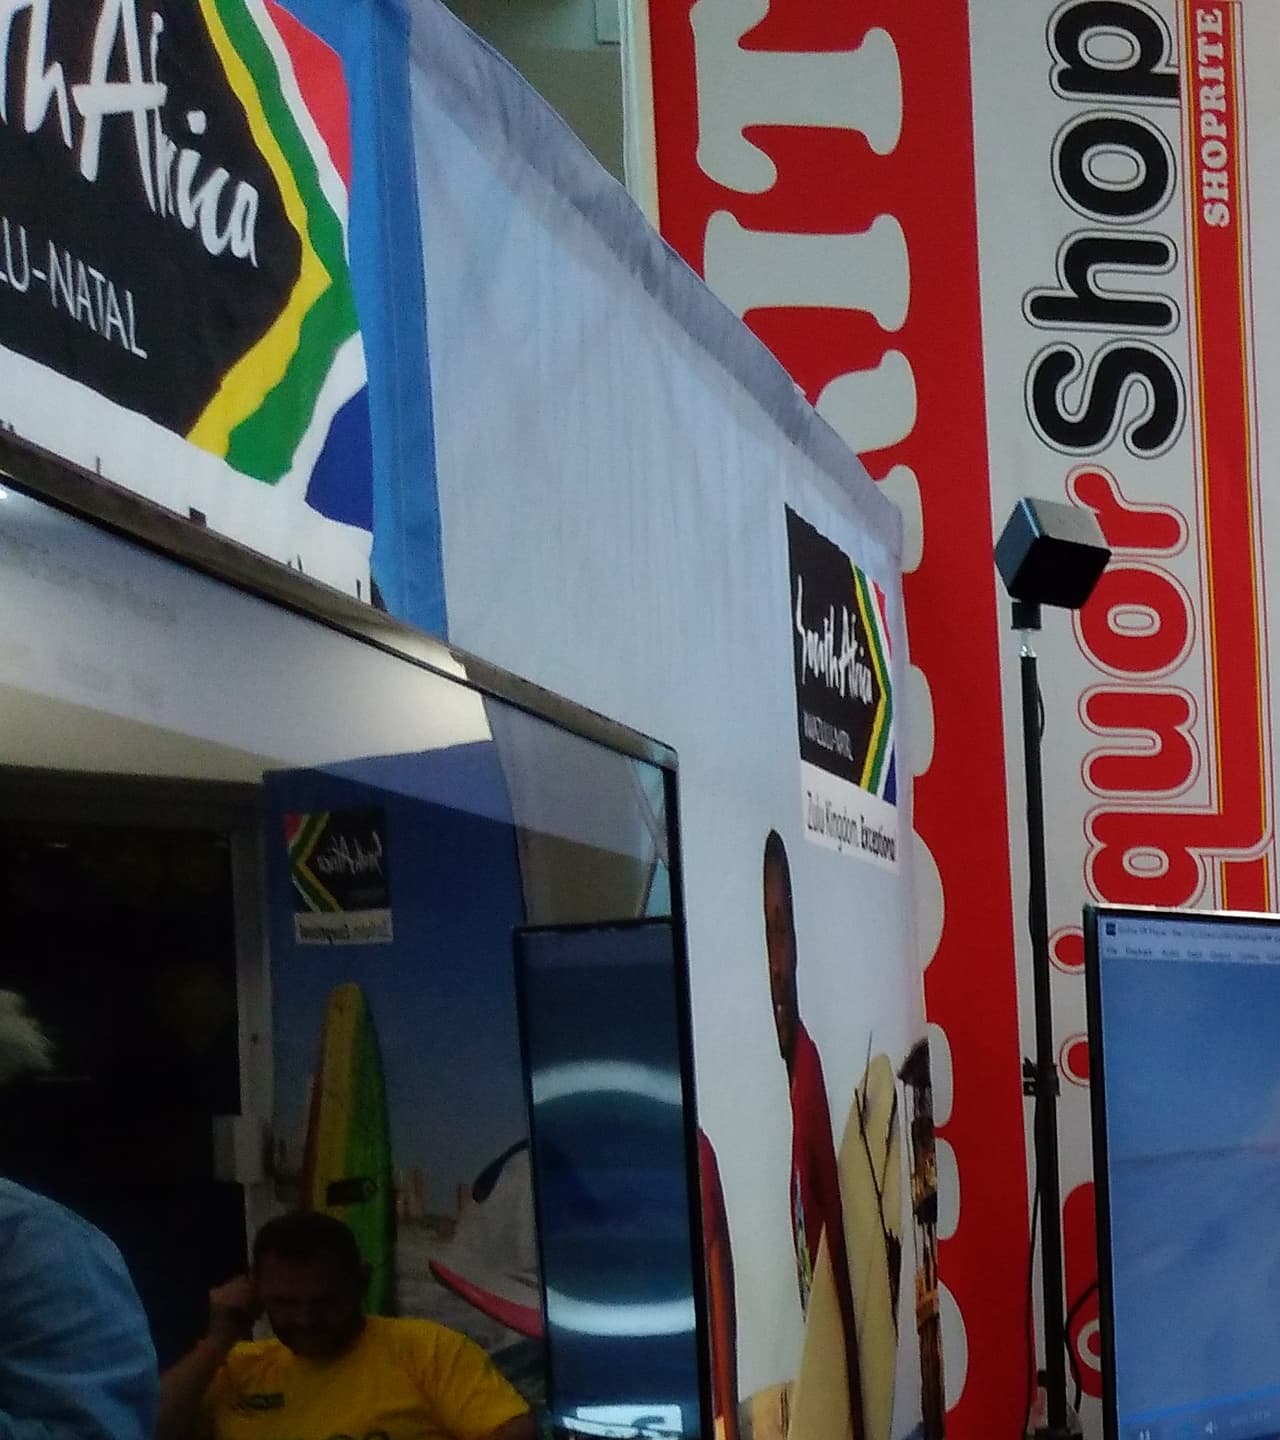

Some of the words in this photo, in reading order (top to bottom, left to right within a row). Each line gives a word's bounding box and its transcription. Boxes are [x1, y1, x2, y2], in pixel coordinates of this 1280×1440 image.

[72, 0, 258, 268] Africa
[1196, 8, 1230, 228] SHOPRITE
[0, 215, 148, 360] U-NATAL
